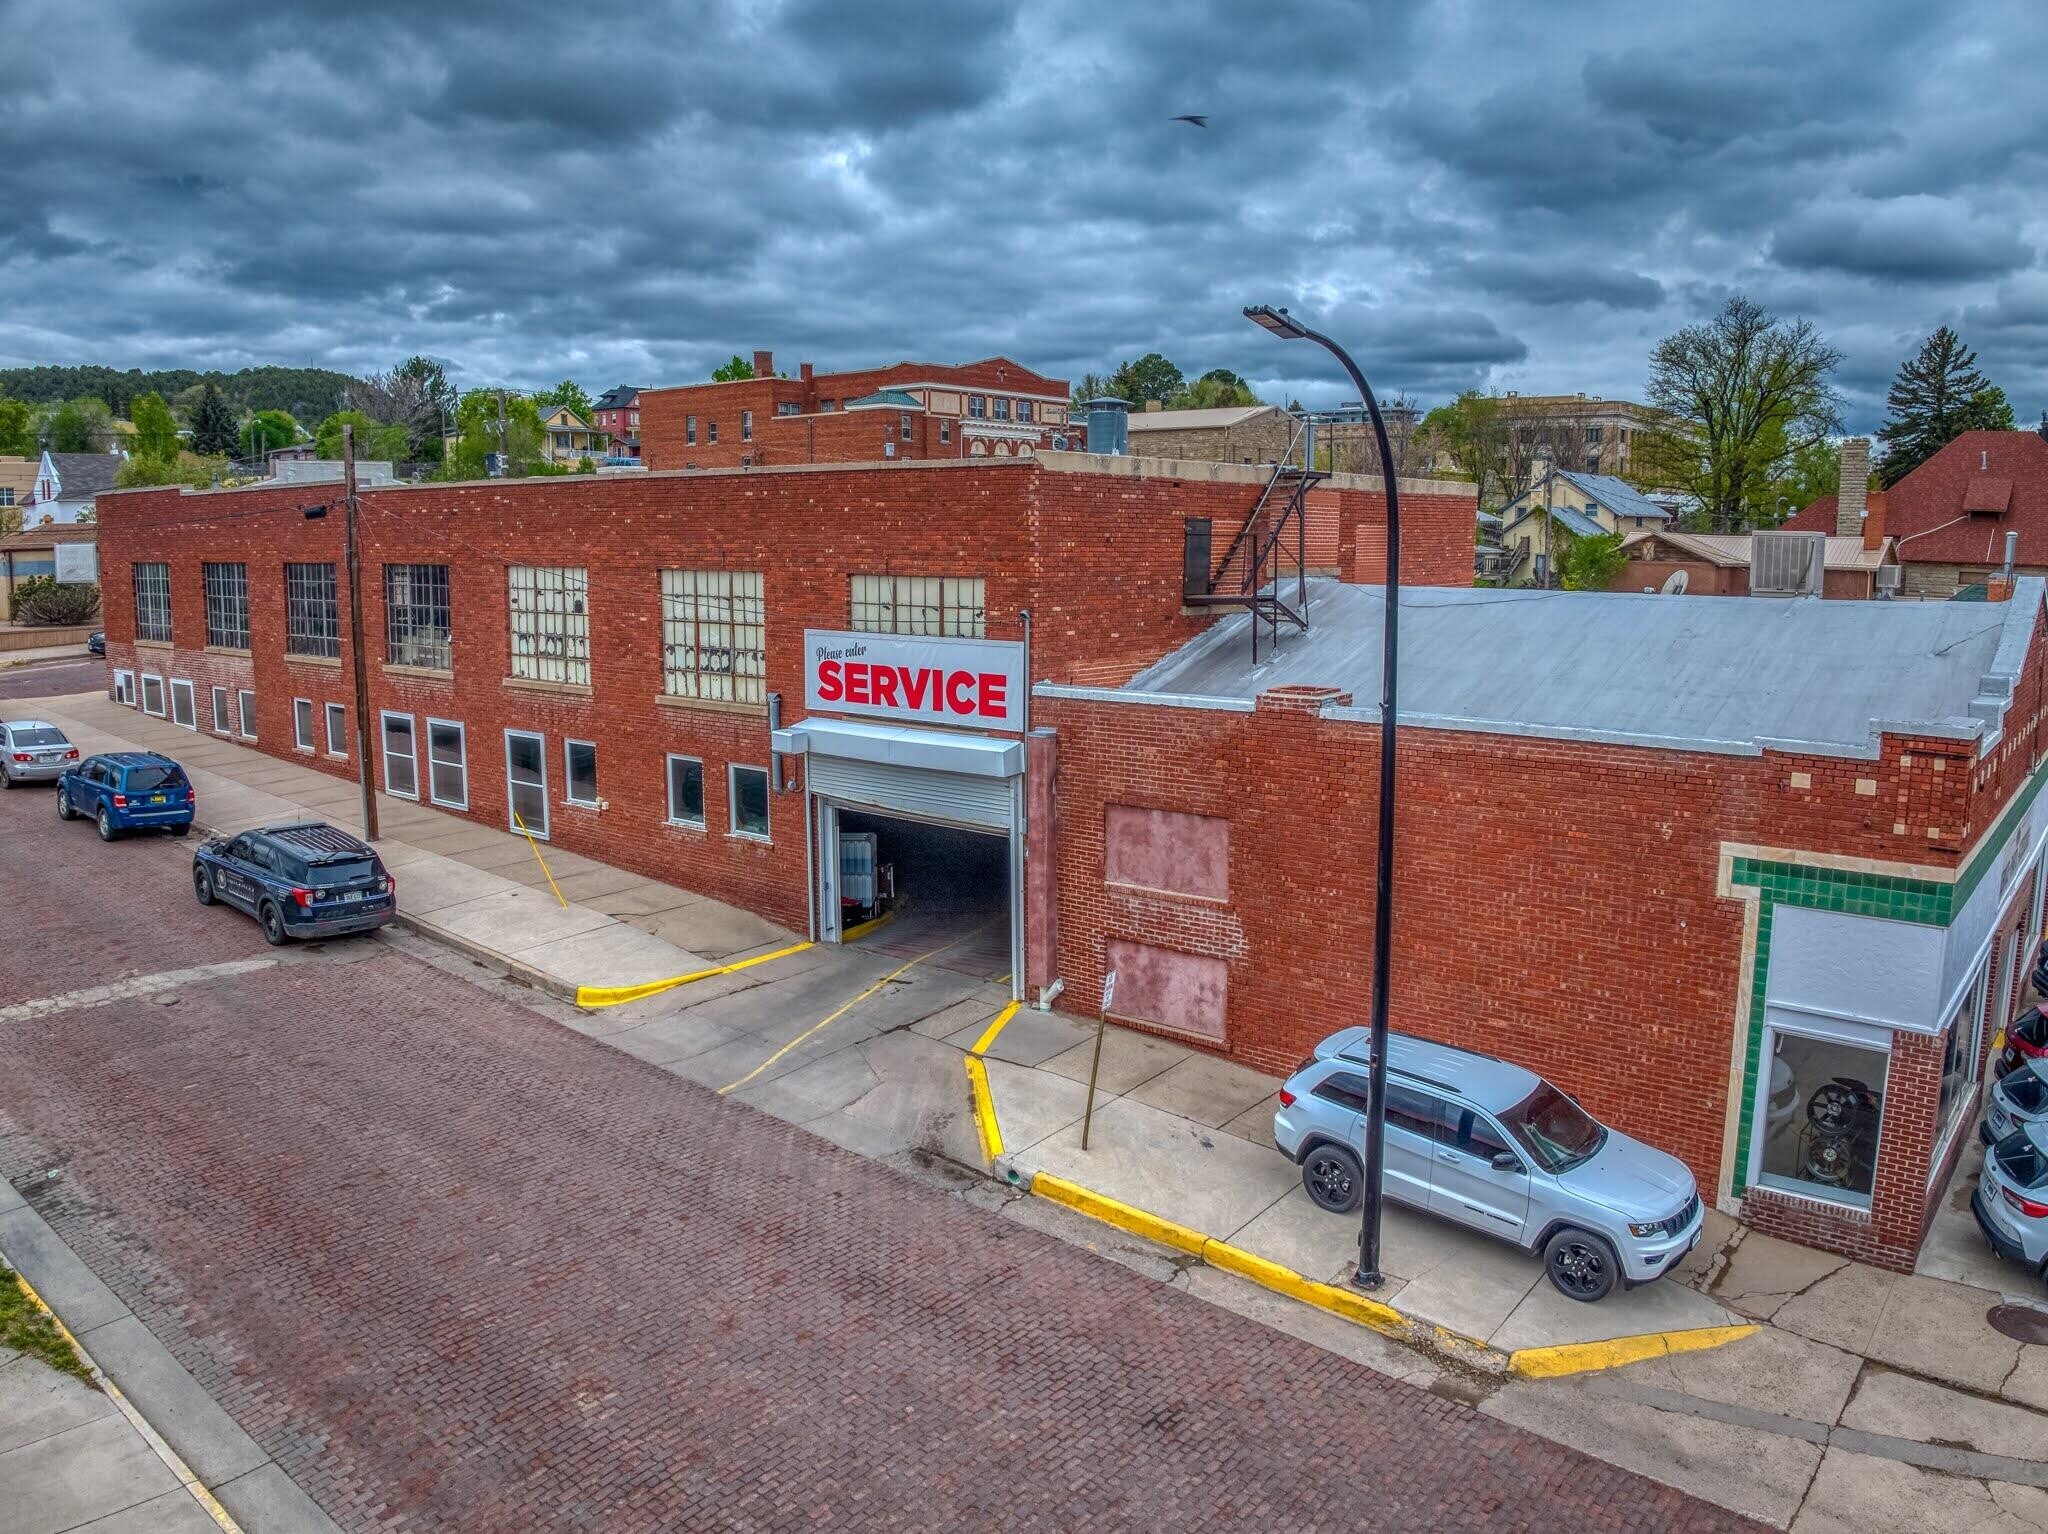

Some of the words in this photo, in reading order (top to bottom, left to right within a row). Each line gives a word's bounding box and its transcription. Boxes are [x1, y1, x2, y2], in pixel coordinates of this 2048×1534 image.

[816, 646, 842, 661] Please
[845, 642, 866, 657] enter
[817, 660, 1007, 718] SERVICE
